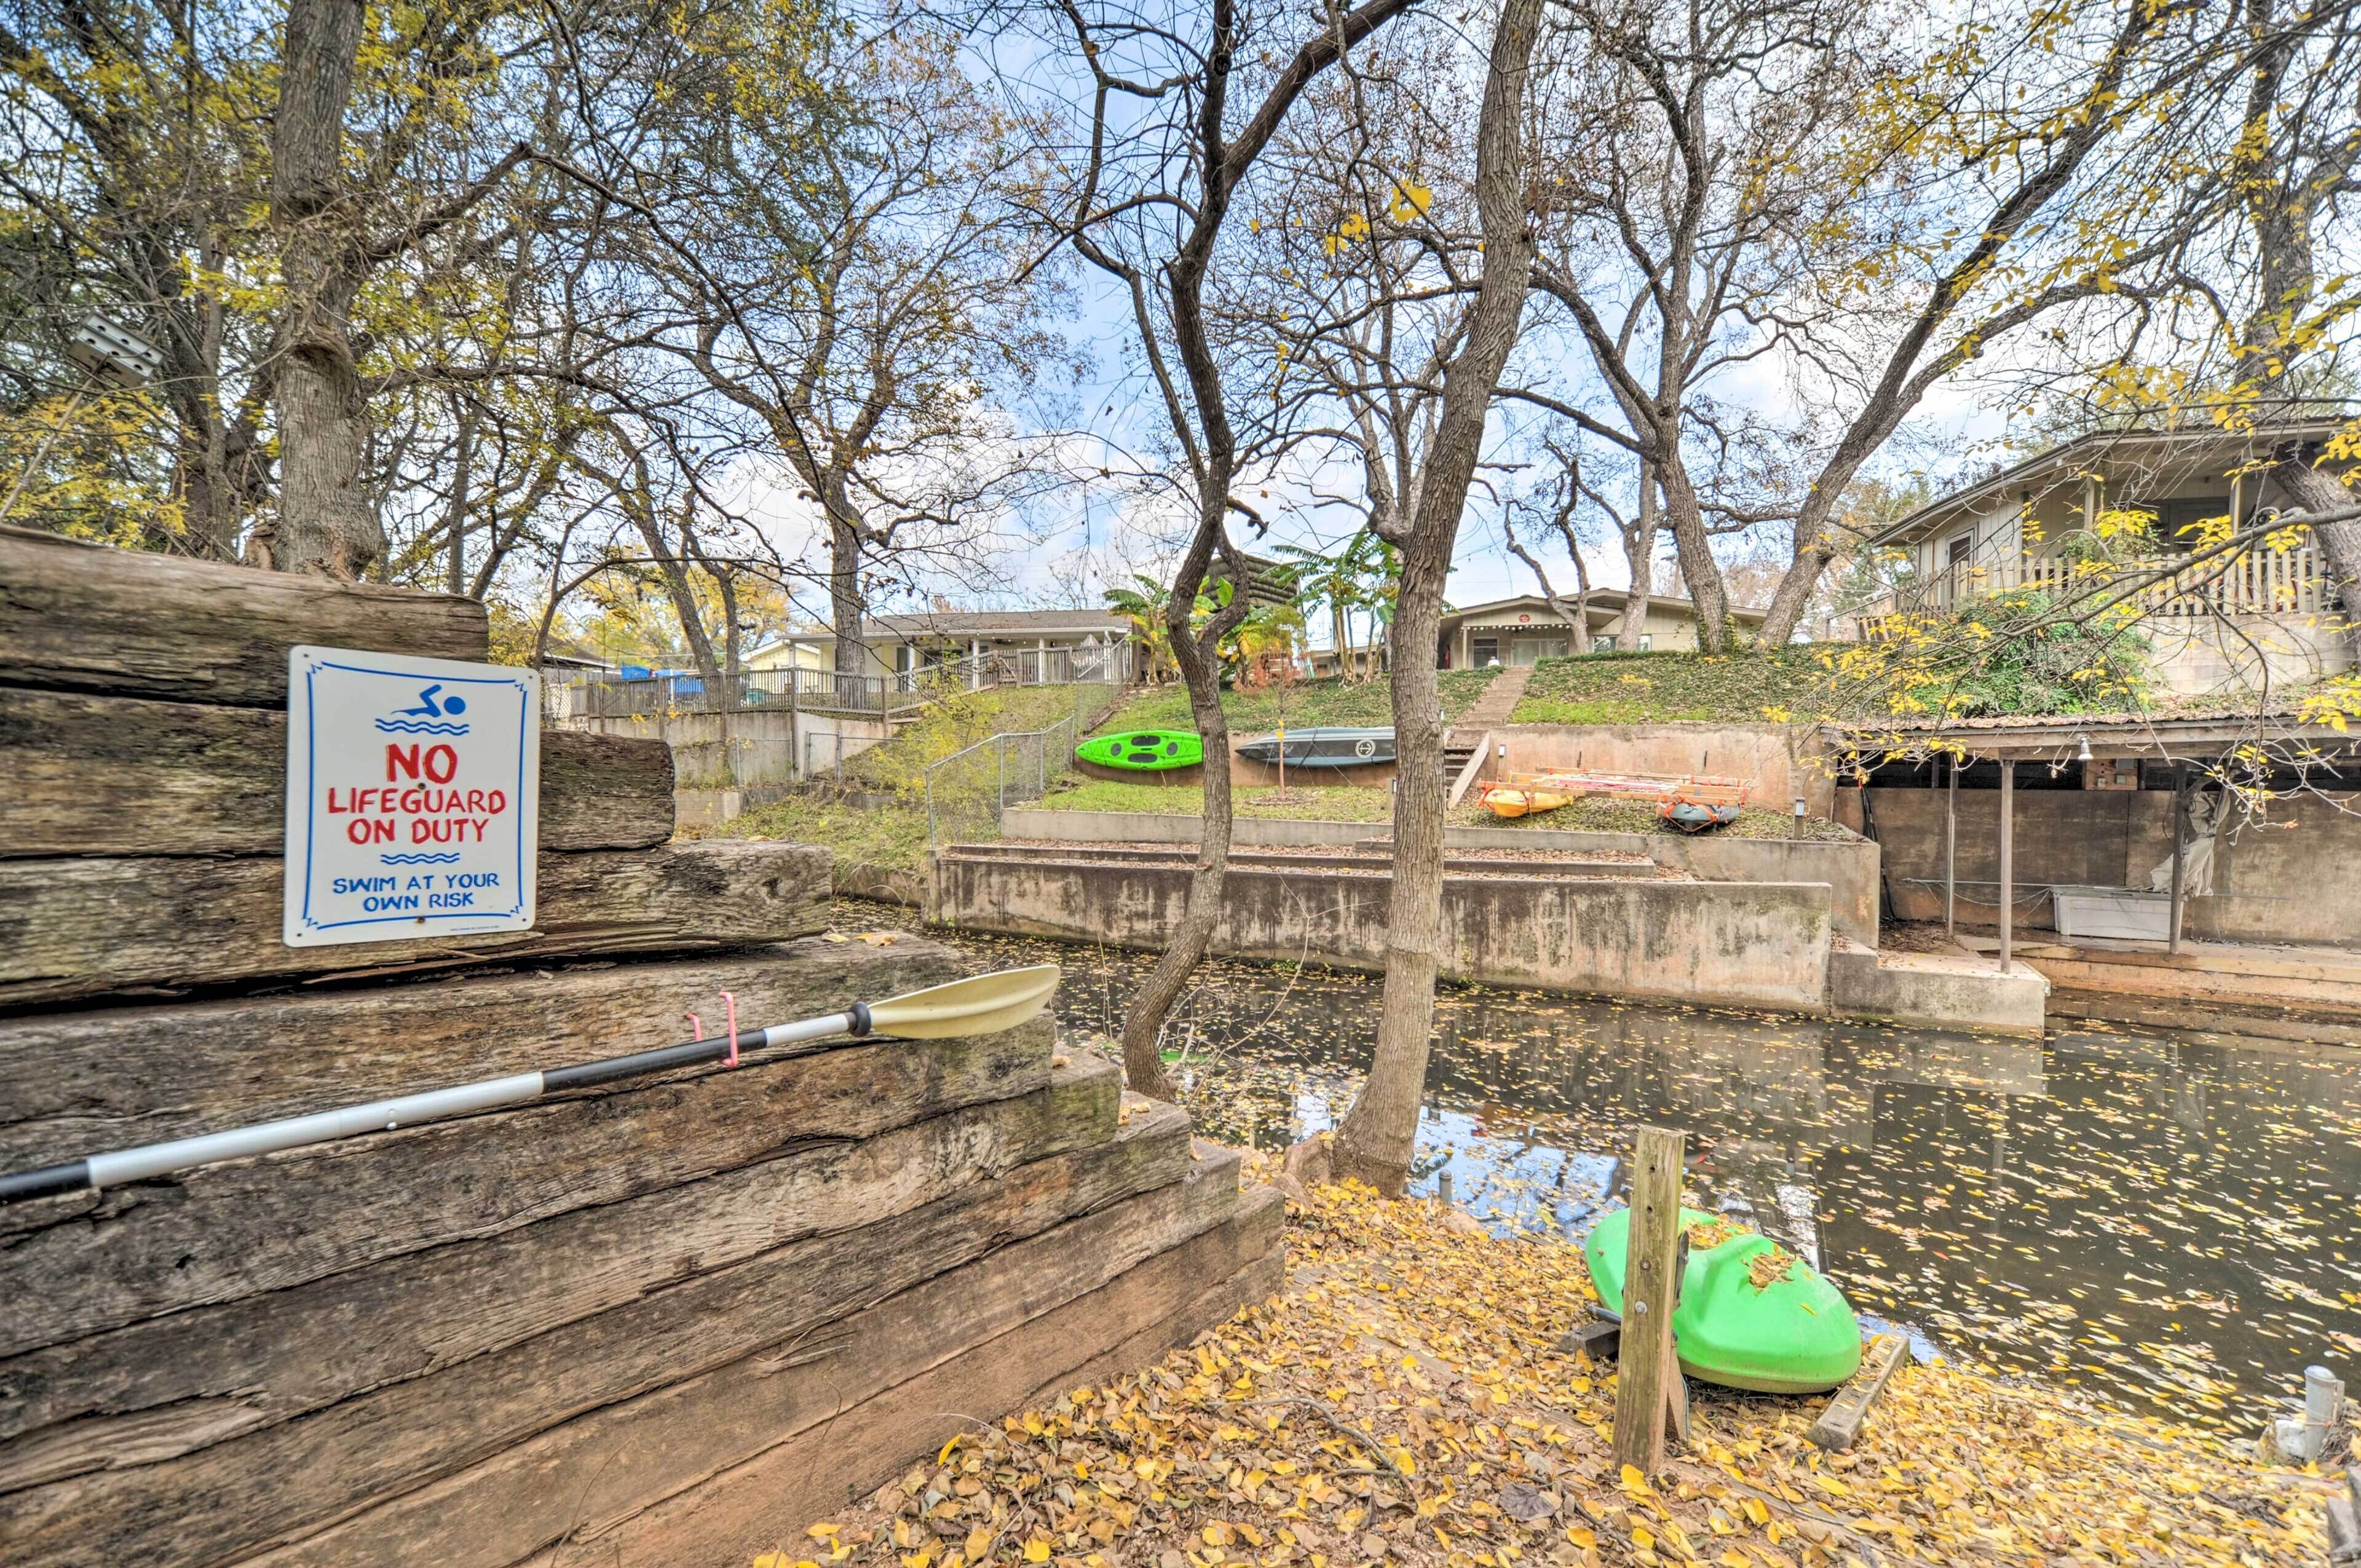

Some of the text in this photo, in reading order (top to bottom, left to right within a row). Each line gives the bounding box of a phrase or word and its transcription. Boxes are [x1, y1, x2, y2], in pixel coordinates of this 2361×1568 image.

[387, 743, 458, 784] NO
[328, 787, 506, 814] LIFEGUARD
[348, 818, 489, 844] ON DUTY
[333, 873, 499, 894] SWIM AT YOUR
[363, 893, 474, 912] OWN RISK
